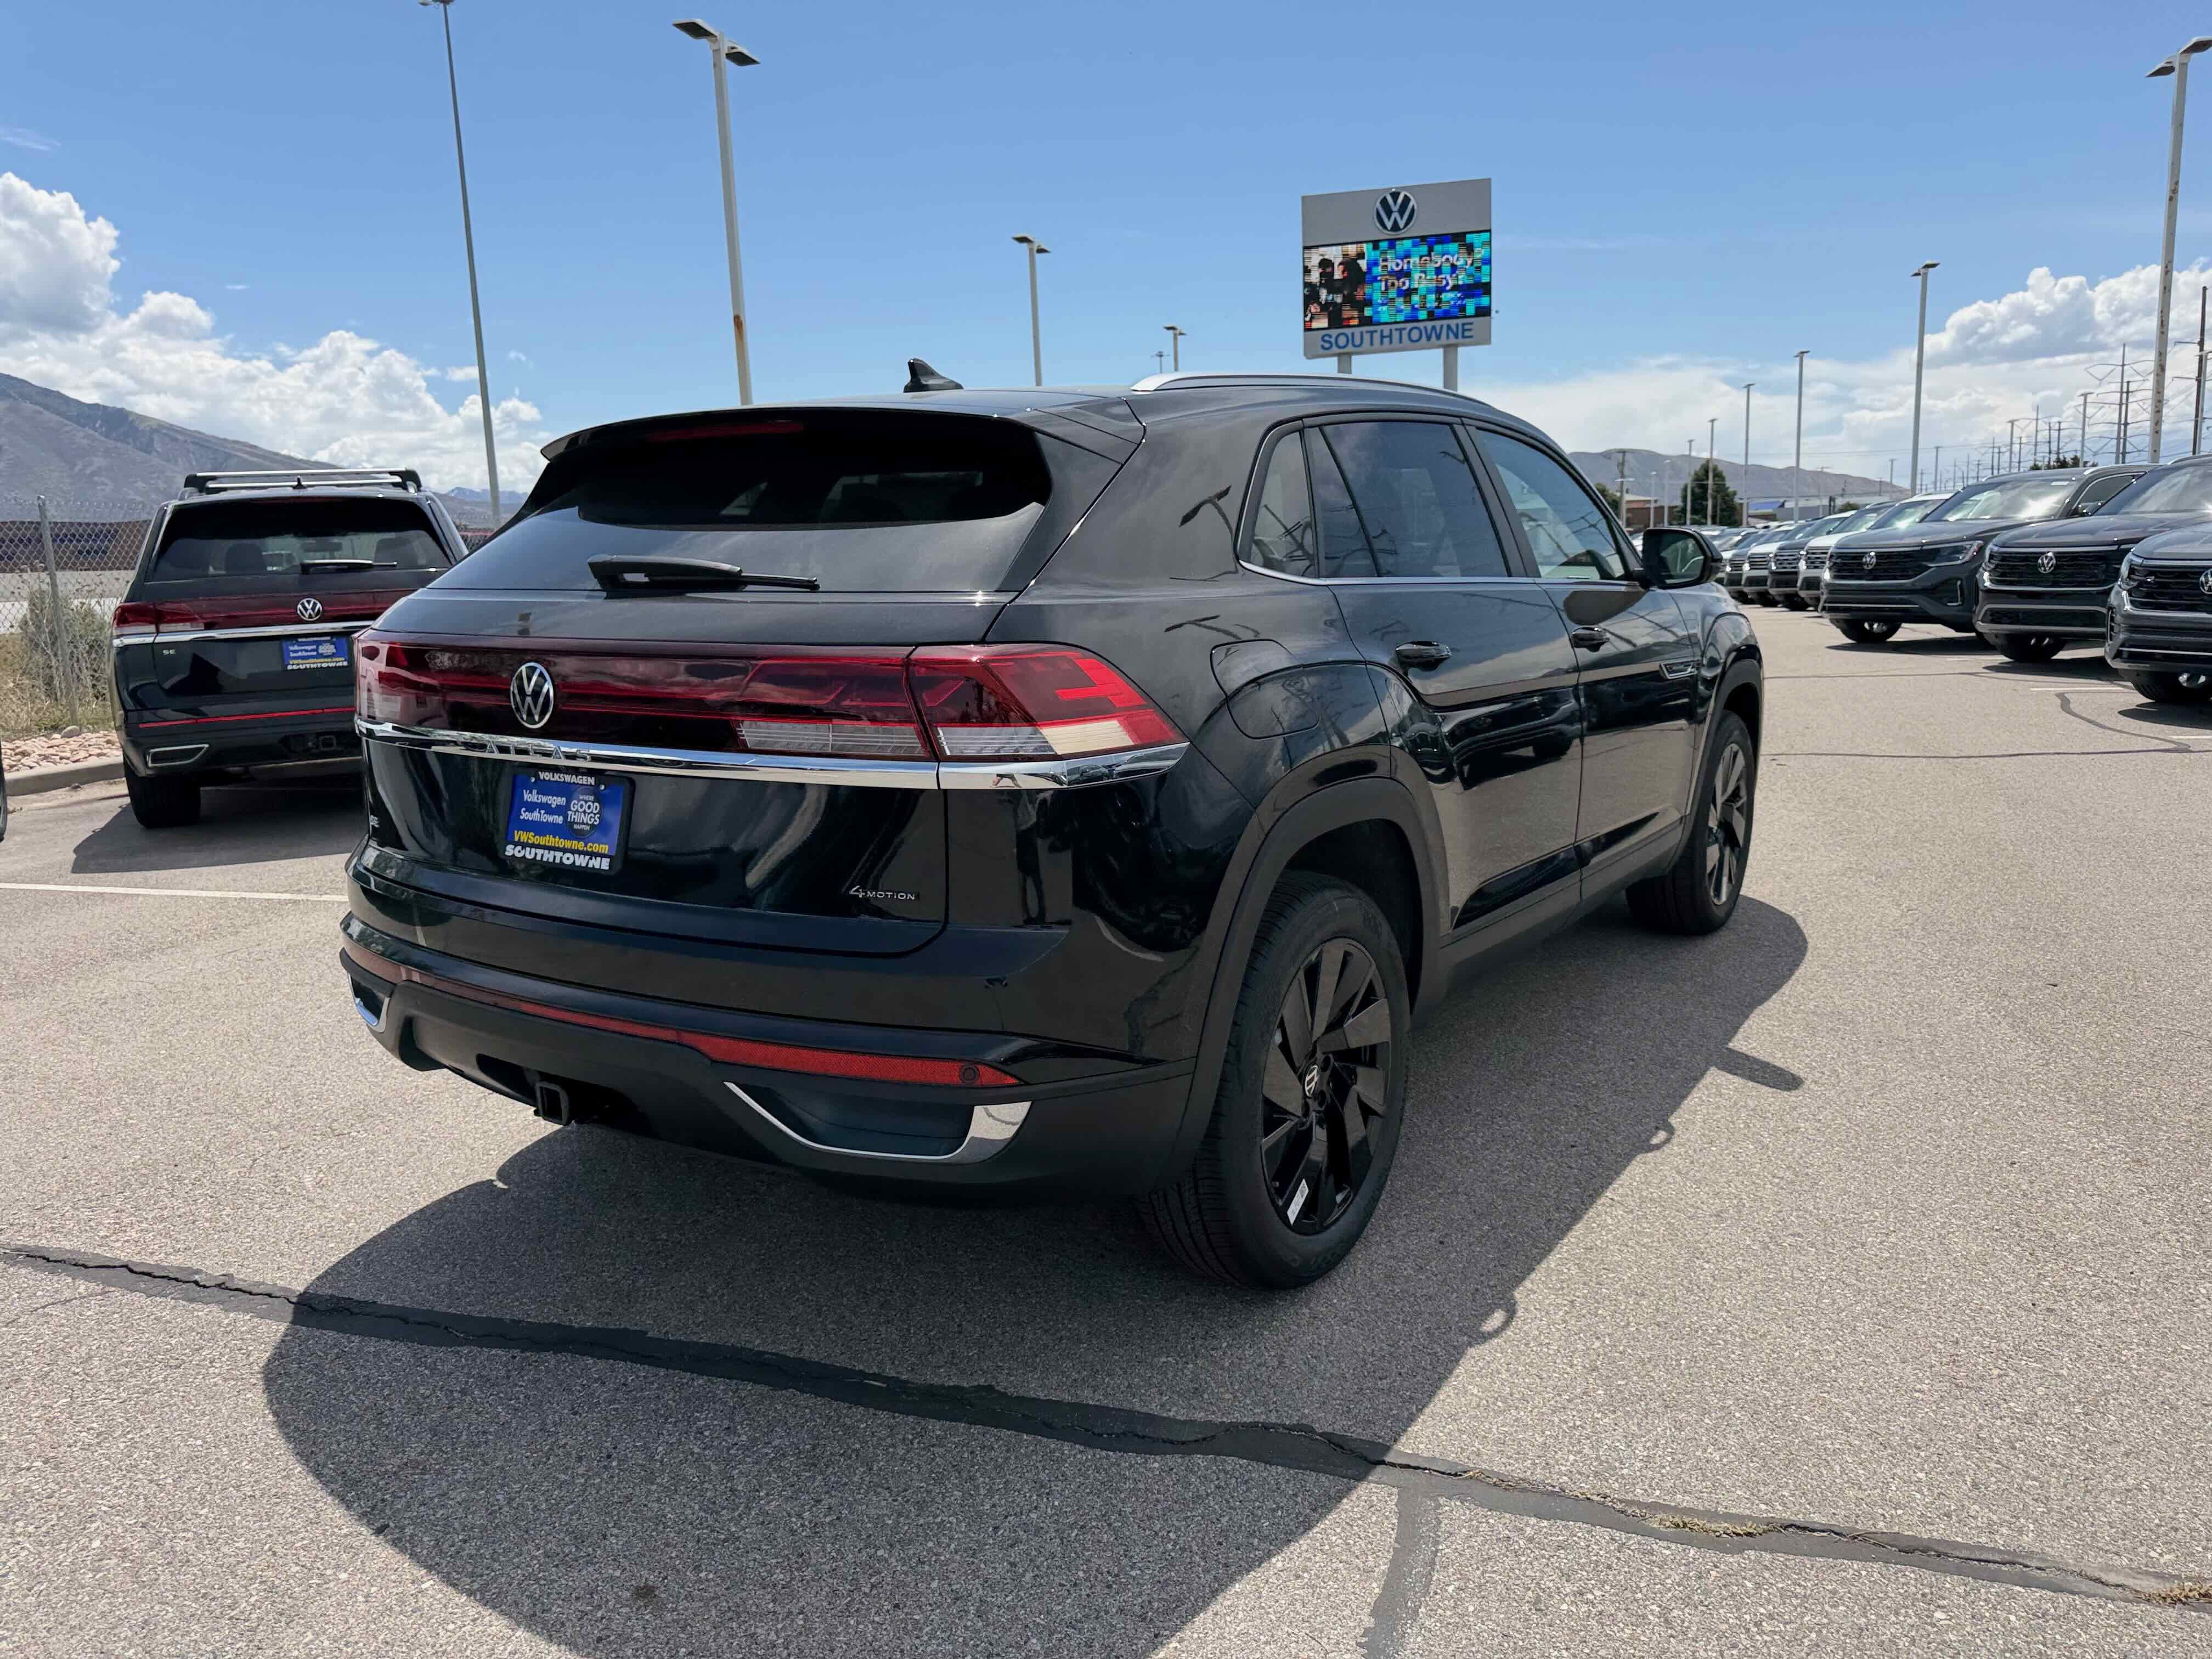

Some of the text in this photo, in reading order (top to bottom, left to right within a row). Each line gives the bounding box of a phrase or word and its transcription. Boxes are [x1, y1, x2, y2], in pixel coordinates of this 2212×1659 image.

[1321, 321, 1474, 351] SOUTHTOWNE
[512, 664, 551, 723] VW
[486, 741, 592, 762] ATLAS
[538, 771, 595, 786] VOLKSWAGEN
[523, 789, 566, 808] Volkswagen
[570, 799, 600, 814] GOOD
[520, 807, 563, 825] SouthTowne
[567, 810, 600, 826] THINGS
[514, 830, 609, 854] VWSouthtowne.com
[504, 844, 611, 870] SOUTHTOWNE
[849, 885, 915, 900] 4MOTION
